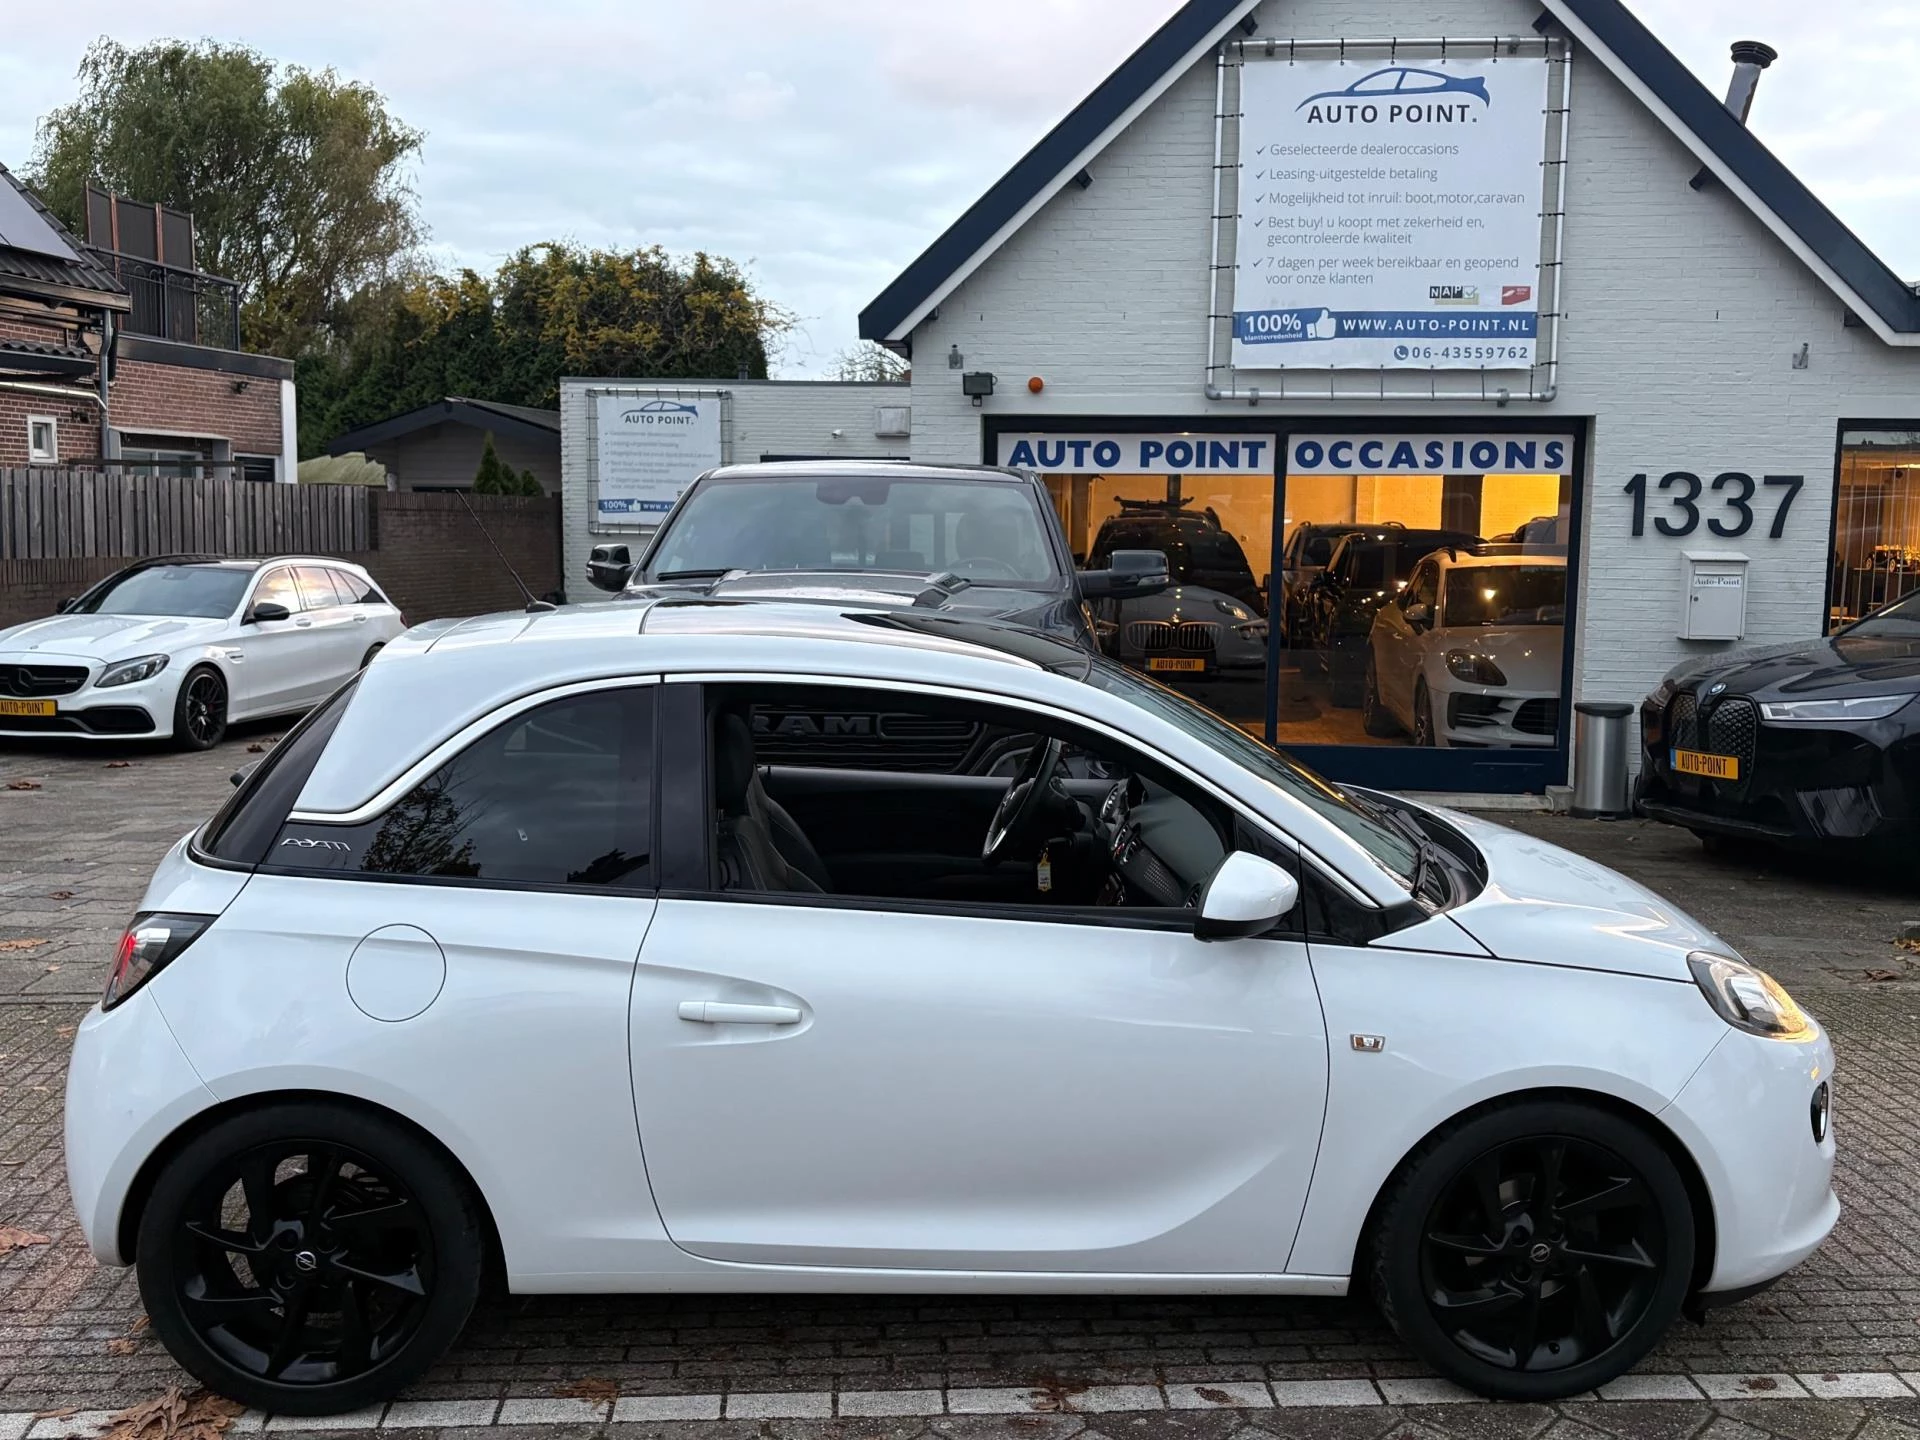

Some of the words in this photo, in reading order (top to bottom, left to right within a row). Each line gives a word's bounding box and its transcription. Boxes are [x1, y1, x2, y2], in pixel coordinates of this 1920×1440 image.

[1307, 104, 1378, 123] AUTO
[1390, 104, 1478, 123] POINT.
[1270, 143, 1357, 156] Geselecteerde
[1360, 143, 1459, 155] dealeroccasions
[1270, 168, 1386, 182] Leasing-uitgestelde
[1389, 168, 1438, 182] betaling
[1269, 192, 1344, 206] Mogelijkheid
[1348, 193, 1365, 204] tot
[1368, 191, 1402, 204] inruil:
[1405, 191, 1525, 205] boot,motor,caravan
[1268, 216, 1294, 228] Best
[1298, 216, 1323, 231] buy!
[1327, 218, 1335, 228] u
[1338, 216, 1372, 230] koopt
[1376, 217, 1402, 228] met
[1403, 216, 1463, 228] zekerheid
[1267, 232, 1359, 247] gecontroleerde
[1363, 233, 1412, 244] kwaliteit
[1266, 257, 1274, 268] 7
[1277, 256, 1314, 271] dagen
[1318, 258, 1339, 271] per
[1343, 256, 1374, 268] week
[1377, 256, 1442, 268] bereikbaar
[1446, 259, 1461, 268] en
[1464, 256, 1519, 271] geopend
[1266, 275, 1292, 284] voor
[1296, 274, 1325, 284] onze
[1329, 273, 1374, 284] klanten
[1430, 286, 1463, 298] NAP
[1245, 313, 1301, 333] 100%
[1342, 318, 1530, 331] WWW.AUTO-POINT.NL
[1411, 346, 1528, 359] 06-43559762
[624, 415, 654, 424] AUTO
[1008, 440, 1121, 468] AUTO
[1140, 440, 1267, 468] POINT
[1294, 440, 1564, 469] OCCASIONS
[1623, 471, 1804, 539] 1337
[1681, 751, 1727, 776] AUTO-POINT
